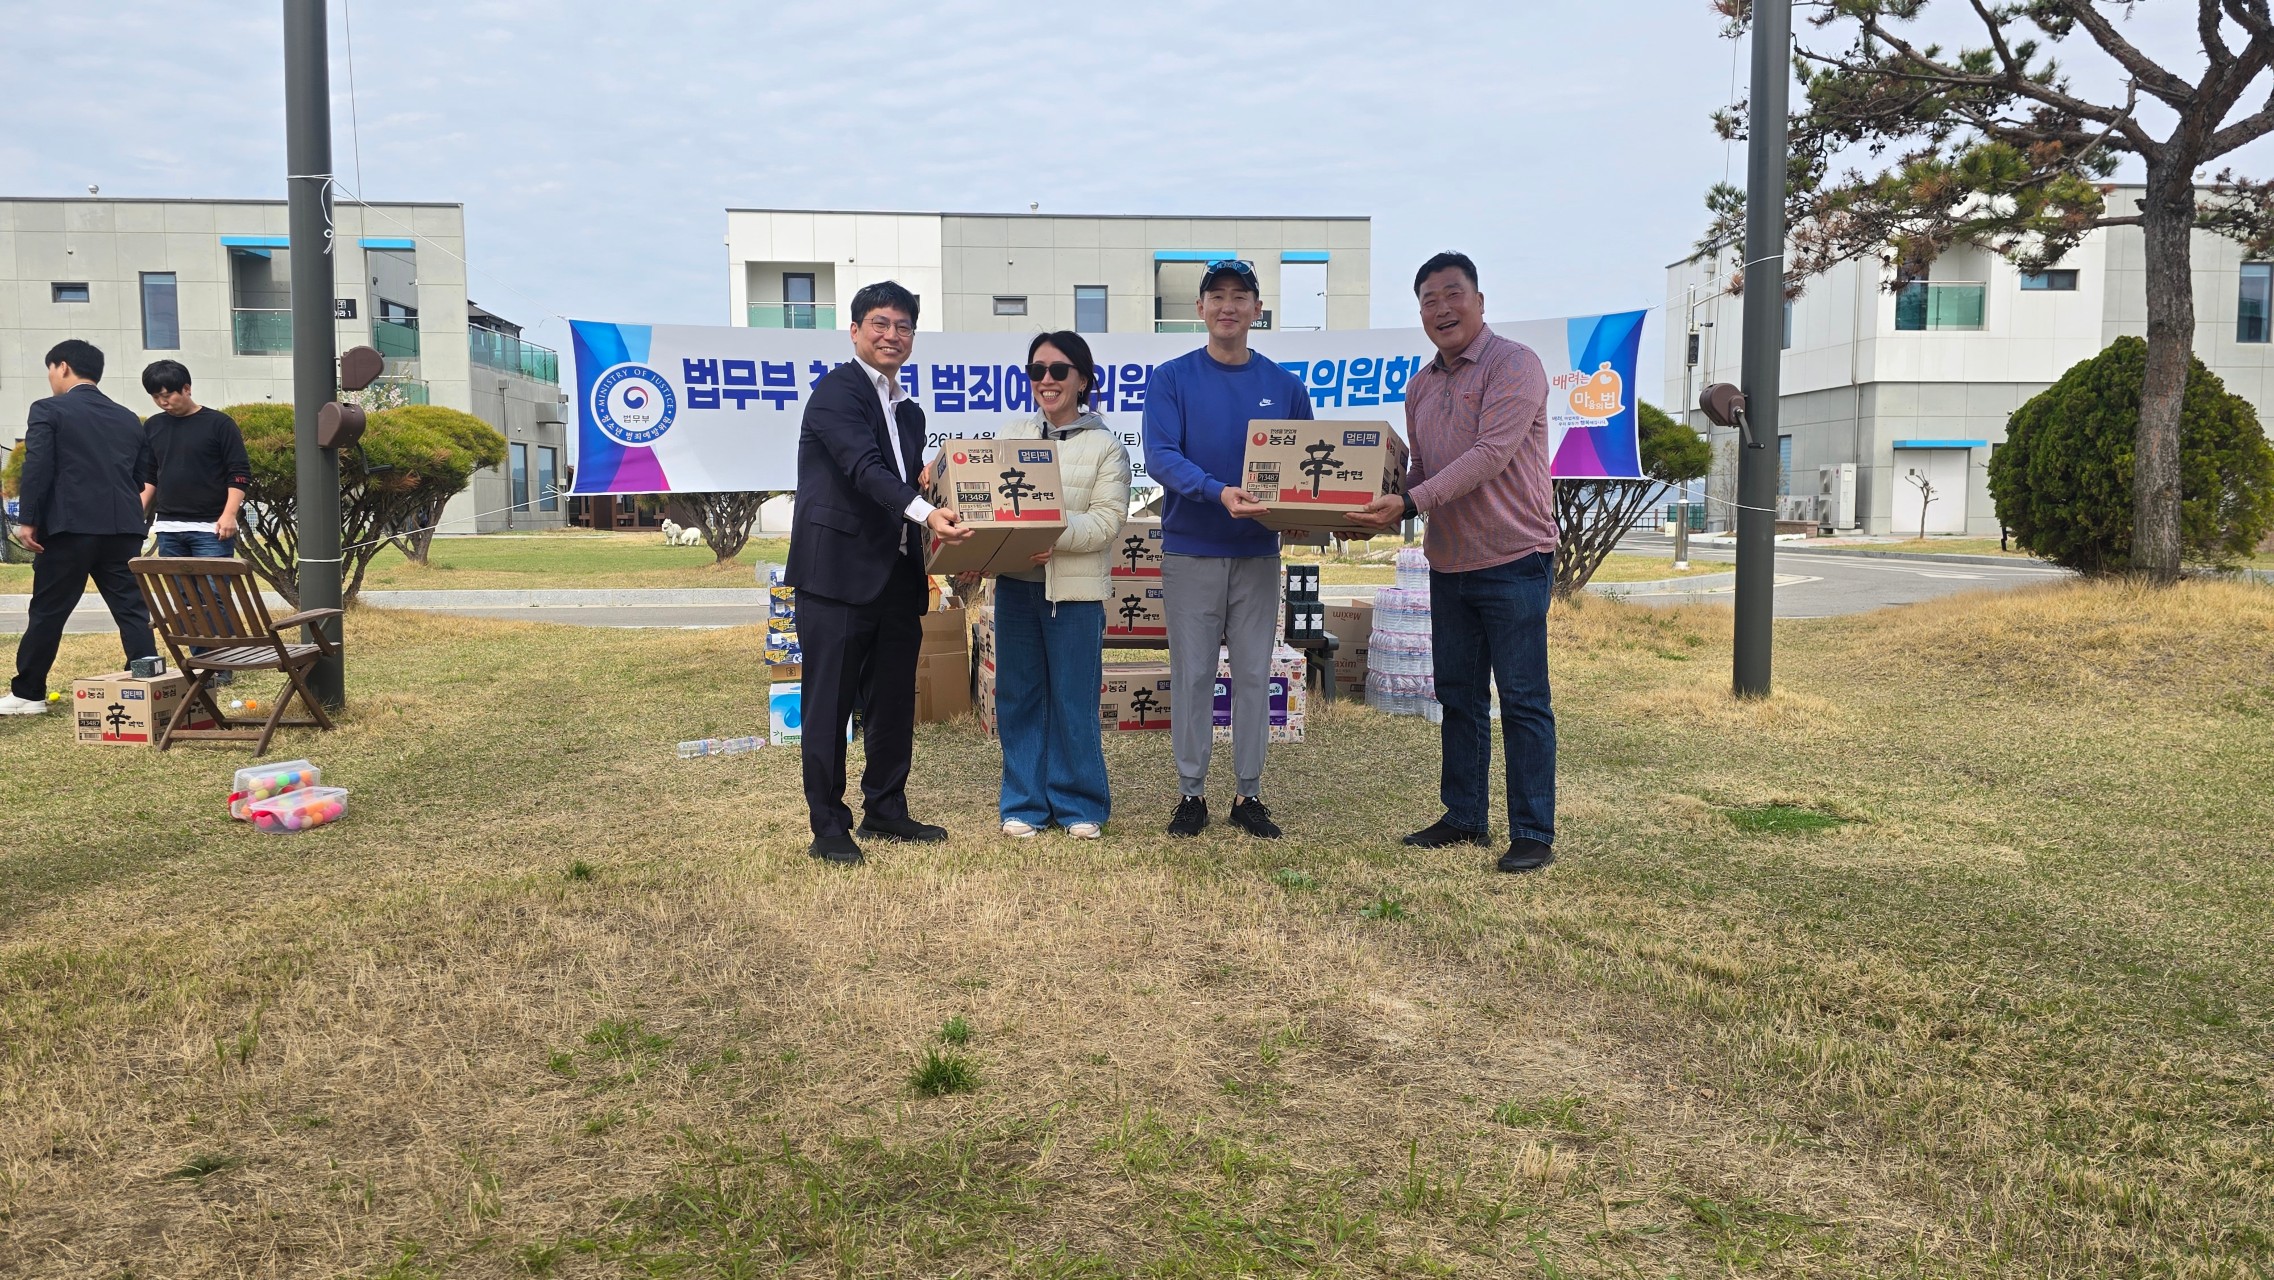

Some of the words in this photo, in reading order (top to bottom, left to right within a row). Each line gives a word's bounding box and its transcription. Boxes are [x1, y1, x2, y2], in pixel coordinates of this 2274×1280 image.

[598, 369, 628, 407] MINISTRY
[633, 368, 647, 377] OF
[651, 375, 674, 409] JUSTICE
[682, 358, 798, 411] 법무부
[932, 363, 1153, 413] 범죄예위원
[1552, 371, 1590, 390] 배려는
[1574, 391, 1604, 411] 마음의
[1600, 391, 1616, 409] 법
[601, 414, 623, 437] 청소년
[623, 414, 650, 423] 법무부
[1269, 434, 1296, 446] 농심
[1346, 433, 1377, 444] 멀티팩
[968, 454, 994, 463] 농심
[1021, 451, 1050, 461] 멀티팩
[1299, 439, 1344, 499] 辛
[1336, 470, 1364, 481] 라면
[960, 493, 990, 501] 가3487
[998, 467, 1036, 517] 辛
[1031, 492, 1055, 501] 라면
[1122, 534, 1151, 573] 辛
[1119, 593, 1147, 632] 辛
[1332, 610, 1362, 621] Maxim
[1334, 659, 1357, 668] axim
[87, 691, 105, 699] 농심
[122, 690, 143, 699] 멀티팩
[162, 688, 177, 699] 농심
[1108, 684, 1127, 692] 농심
[1130, 686, 1159, 727] 辛
[106, 702, 132, 738] 辛
